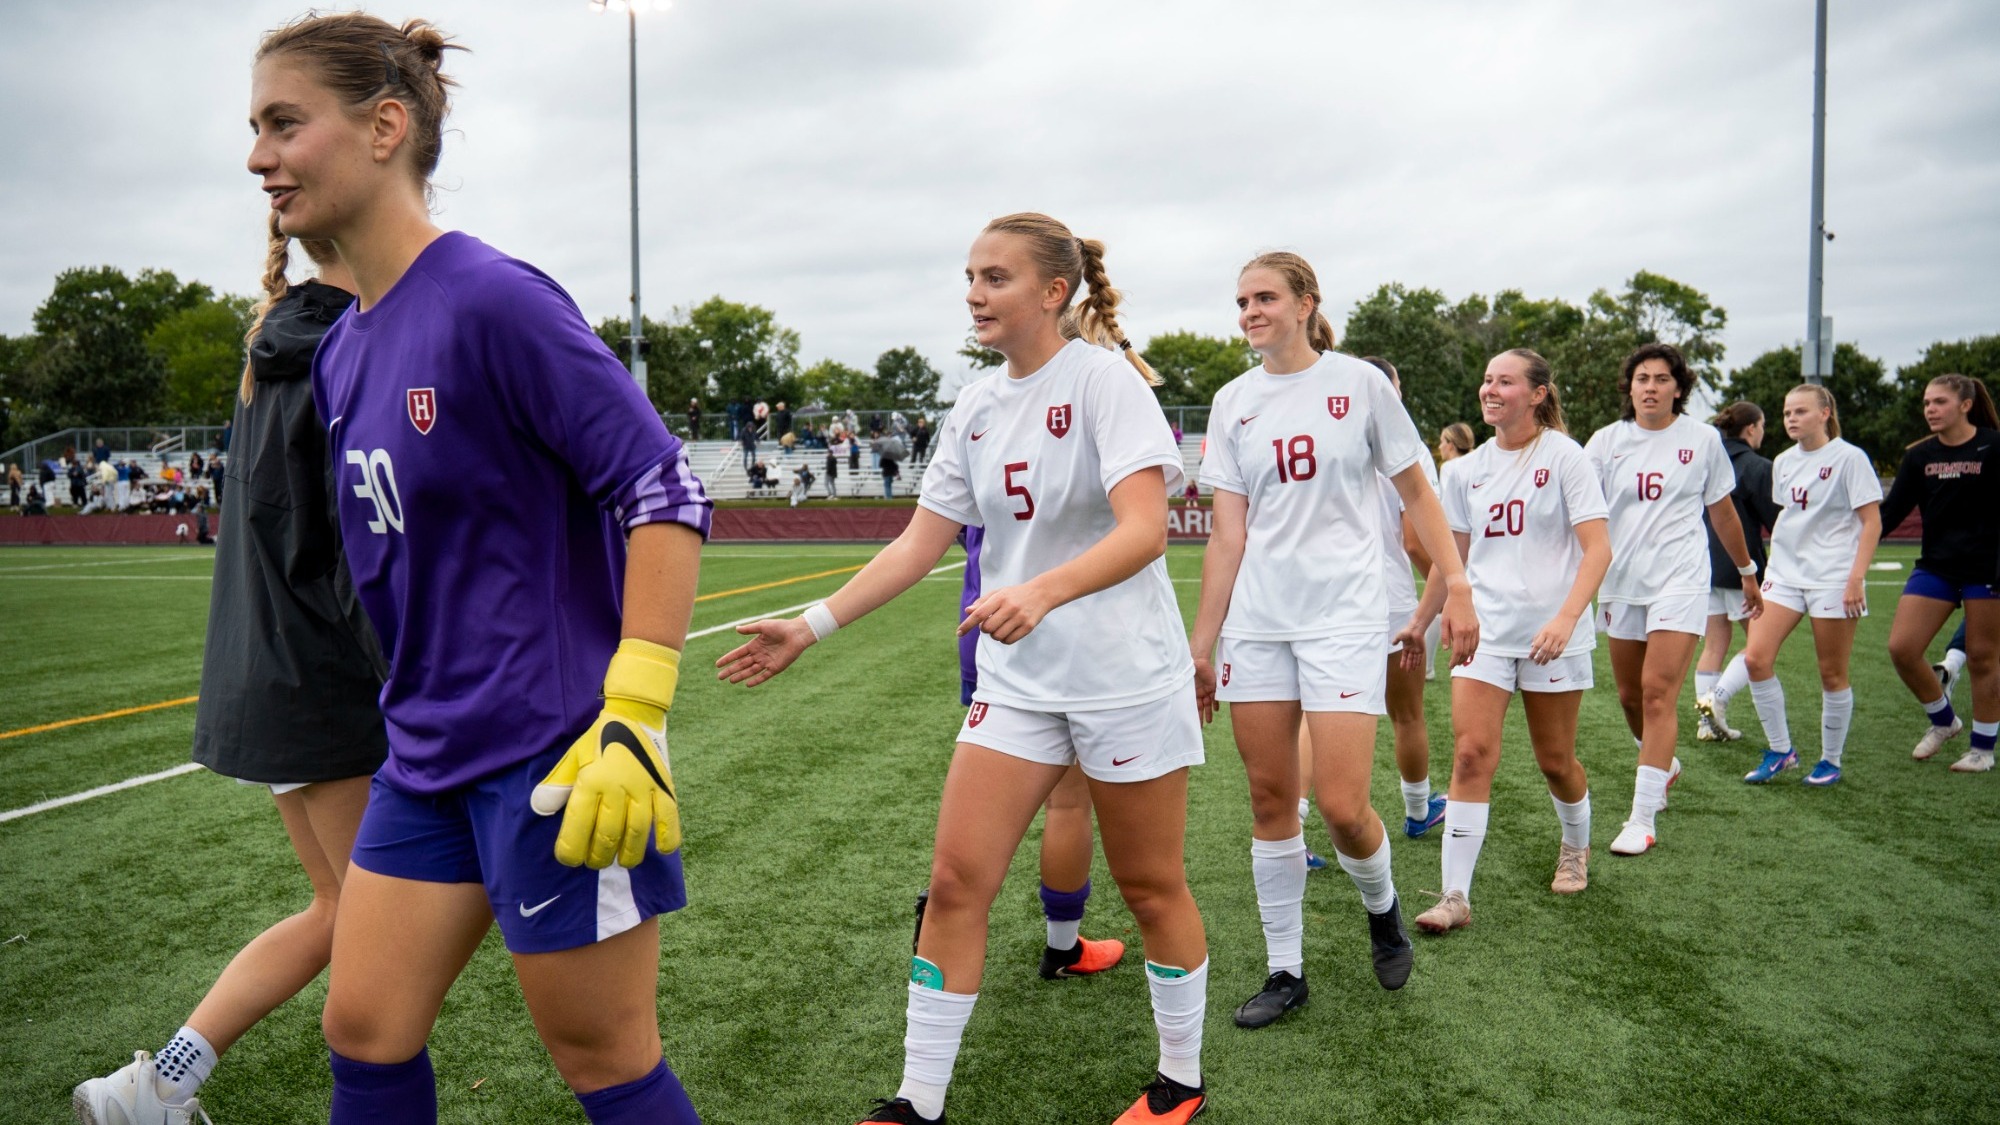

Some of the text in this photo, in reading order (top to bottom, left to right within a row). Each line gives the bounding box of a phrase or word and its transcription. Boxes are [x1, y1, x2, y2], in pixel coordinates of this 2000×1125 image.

[413, 394, 431, 421] H
[1051, 408, 1067, 430] H
[1331, 398, 1346, 414] H
[1272, 434, 1317, 483] 18
[346, 448, 405, 534] 30
[1004, 461, 1035, 521] 5
[1636, 471, 1664, 502] 16
[1484, 499, 1525, 538] 20
[969, 703, 985, 722] H
